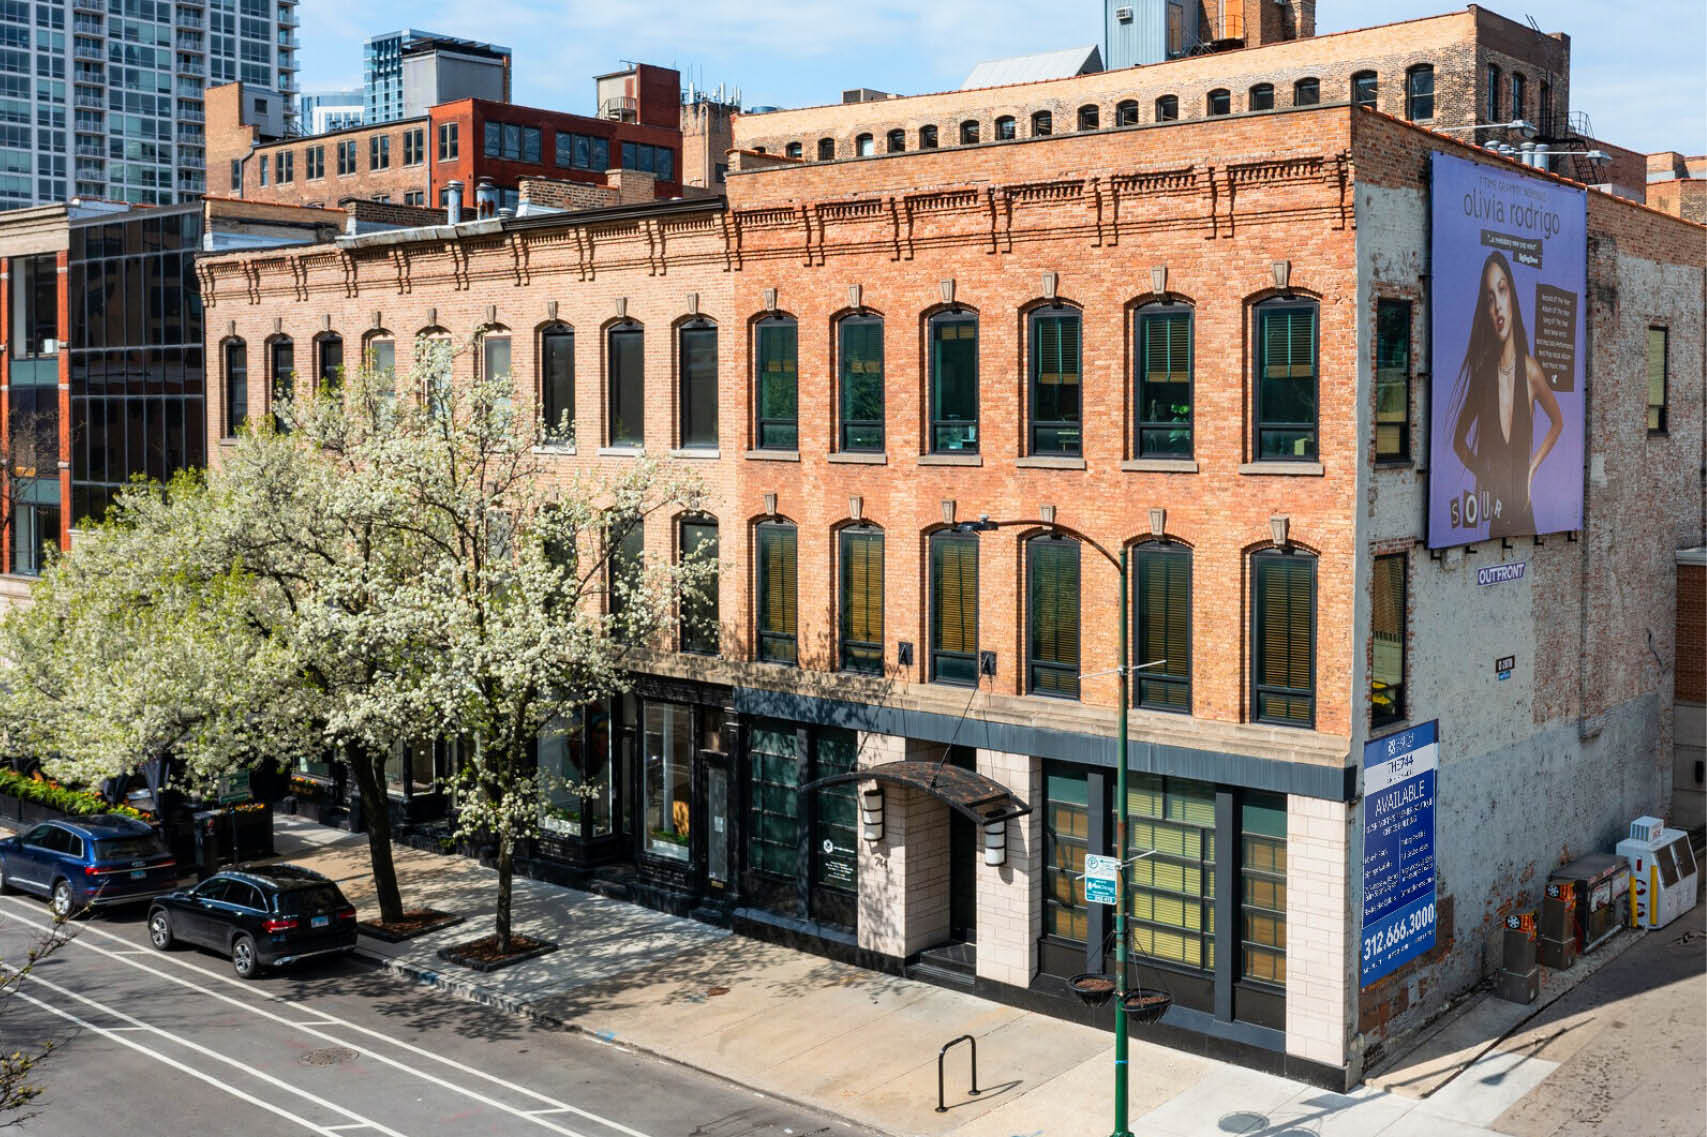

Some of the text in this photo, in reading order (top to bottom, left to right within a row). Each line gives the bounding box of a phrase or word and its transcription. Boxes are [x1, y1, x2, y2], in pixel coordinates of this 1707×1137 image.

[1464, 189, 1560, 240] olivia rodrigo
[1452, 490, 1503, 525] SOUR
[1479, 563, 1525, 584] OUTFRONT
[1375, 779, 1425, 817] AVAILABLE
[1363, 903, 1435, 961] 312.666.3000
